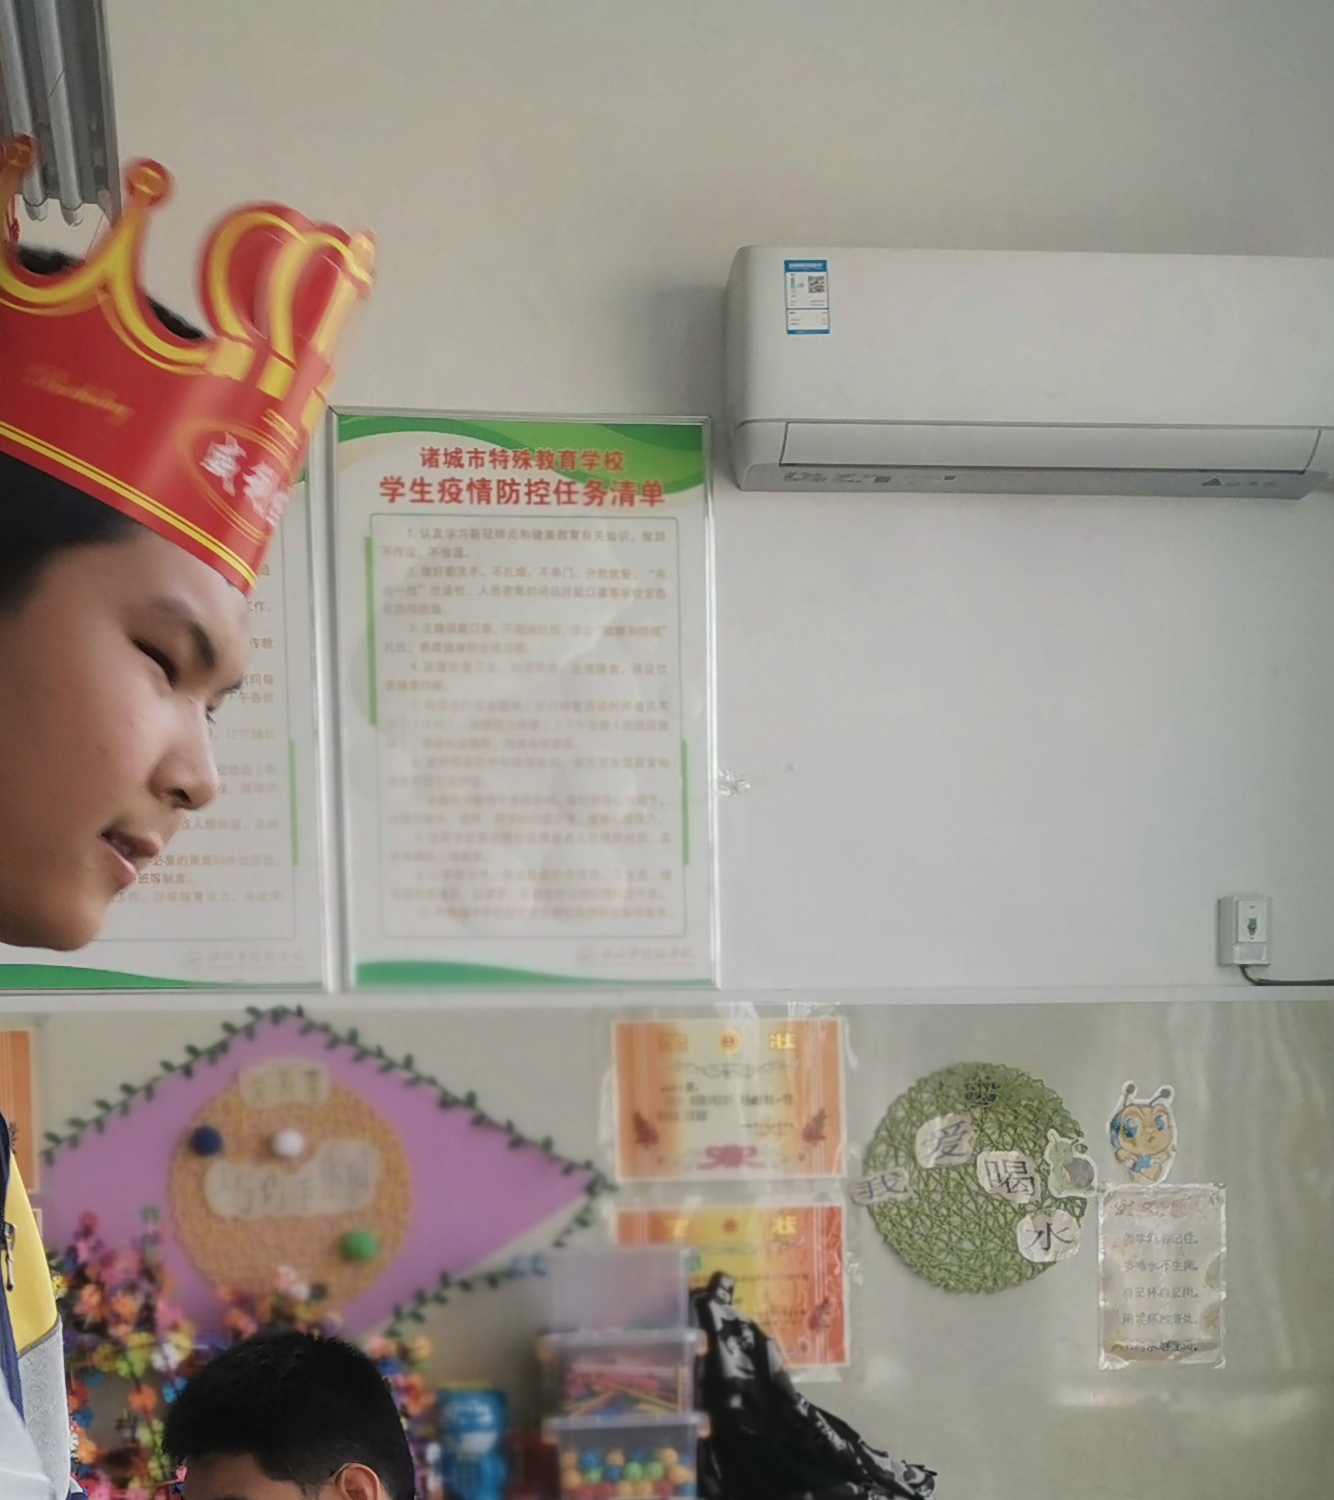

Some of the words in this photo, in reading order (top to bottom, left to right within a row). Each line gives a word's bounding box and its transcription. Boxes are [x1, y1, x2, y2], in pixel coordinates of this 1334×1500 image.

[419, 446, 625, 472] 诸城市特殊教育学校
[379, 475, 665, 508] 学生疫情防控任务清单
